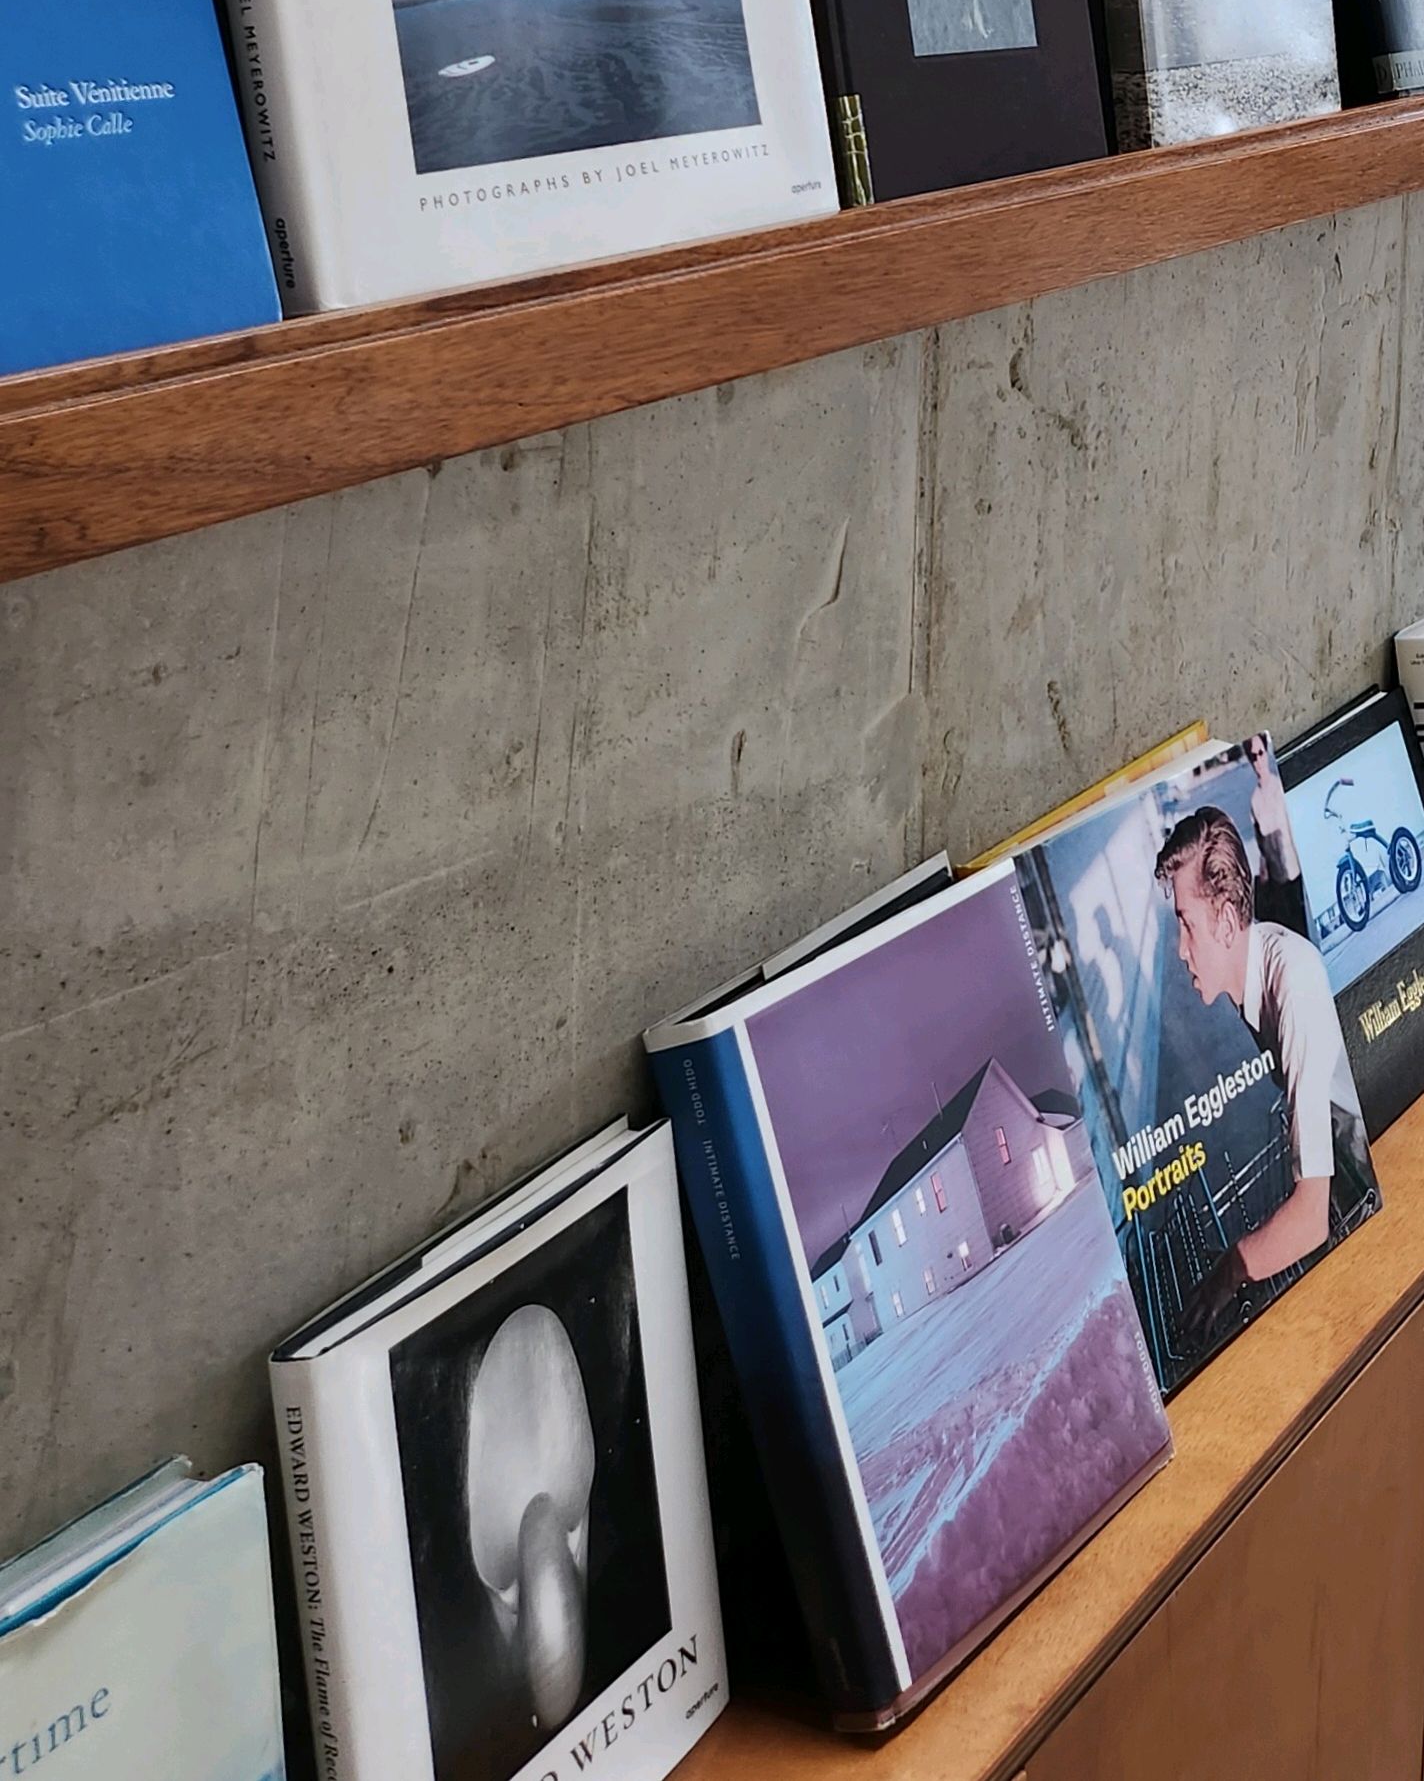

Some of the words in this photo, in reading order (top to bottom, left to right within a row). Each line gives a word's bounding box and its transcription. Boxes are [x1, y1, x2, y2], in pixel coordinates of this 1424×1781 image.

[16, 84, 70, 110] Suite
[69, 78, 175, 106] Vénitienne
[23, 116, 85, 145] Sophie
[86, 111, 133, 137] Calle
[243, 24, 277, 163] MEYEROWITZ
[419, 175, 571, 212] PHOTOGRAPHS
[582, 169, 604, 186] BY
[616, 159, 661, 183] JOEL
[669, 144, 771, 172] MEYEROWITZ
[275, 217, 296, 290] aperture
[1010, 885, 1035, 957] DISTANCE
[1030, 960, 1056, 1032] INTIMATE
[1359, 999, 1402, 1044] William
[683, 1058, 698, 1091] HIDO
[691, 1092, 707, 1125] TODD
[1112, 1112, 1186, 1181] William
[1184, 1048, 1276, 1129] Eggleston
[702, 1139, 726, 1198] INTIMATE
[718, 1201, 741, 1260] DISTANCE
[1122, 1141, 1207, 1222] Portraits
[286, 1406, 310, 1503] EDWARD
[298, 1509, 323, 1611] WESTON:
[309, 1617, 325, 1653] The
[310, 1657, 332, 1717] Flame
[570, 1634, 698, 1772] WESTON
[685, 1682, 719, 1719] aperture
[0, 1686, 111, 1777] time
[321, 1720, 338, 1743] of
